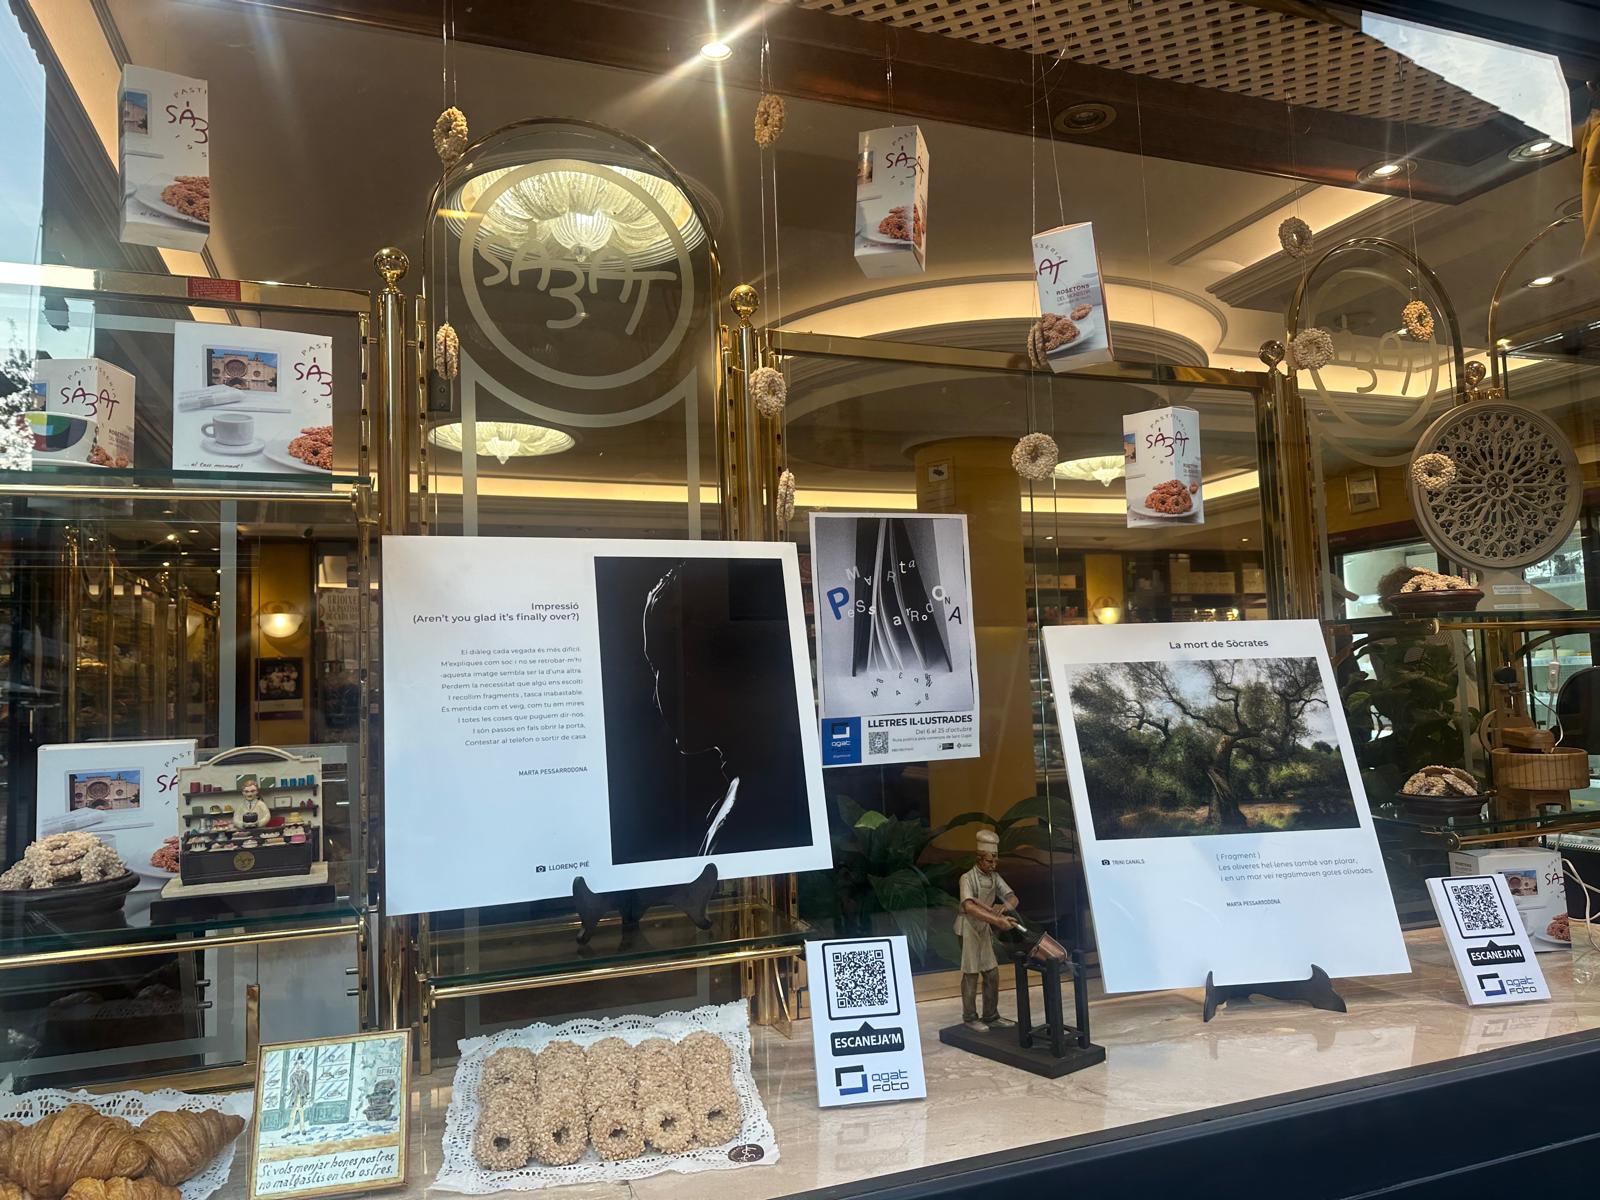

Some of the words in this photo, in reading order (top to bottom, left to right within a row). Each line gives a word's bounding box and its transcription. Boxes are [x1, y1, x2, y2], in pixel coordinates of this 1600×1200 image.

[1056, 284, 1090, 295] ROSETONS
[531, 602, 579, 612] Impressió
[413, 614, 448, 624] (Aren't
[451, 615, 472, 624] you
[473, 613, 496, 623] glad
[499, 612, 514, 621] it's
[516, 612, 547, 622] finally
[549, 612, 580, 622] over?)
[1169, 641, 1181, 649] La
[1184, 641, 1209, 649] mort
[1211, 640, 1224, 648] de
[1226, 639, 1269, 648] Sòcrates
[493, 648, 510, 656] cada
[510, 648, 537, 656] vegada
[473, 670, 498, 679] imatge
[499, 669, 525, 677] sembla
[545, 668, 565, 676] d'una
[441, 682, 470, 690] Perdem
[516, 682, 531, 690] que
[452, 693, 482, 701] recollim
[451, 704, 482, 712] mentida
[514, 715, 528, 723] que
[529, 713, 559, 722] puguem
[868, 718, 908, 728] LLETRES
[909, 715, 973, 726] IL·LUSTRADES
[477, 726, 490, 734] són
[491, 727, 515, 735] passos
[946, 726, 972, 734] d'octubre
[465, 738, 501, 746] Contestar
[541, 734, 559, 742] sortir
[570, 733, 586, 741] casa
[540, 765, 588, 775] PESSARRODONA
[548, 862, 578, 871] LLORENÇ
[579, 860, 590, 868] PIÉ
[1232, 863, 1260, 871] oliveres
[1321, 869, 1342, 877] gotes
[1470, 949, 1522, 961] ESCANEJA'M
[1506, 976, 1534, 986] agat
[835, 1033, 902, 1049] ESCANEJA'M
[871, 1069, 908, 1083] agat
[258, 1163, 271, 1178] Si
[272, 1161, 293, 1176] vols
[294, 1159, 331, 1177] menjar
[331, 1155, 358, 1168] bones
[357, 1150, 395, 1171] postres,
[258, 1181, 271, 1191] no
[326, 1172, 338, 1181] en
[340, 1167, 355, 1180] les
[358, 1163, 393, 1177] ostres.
